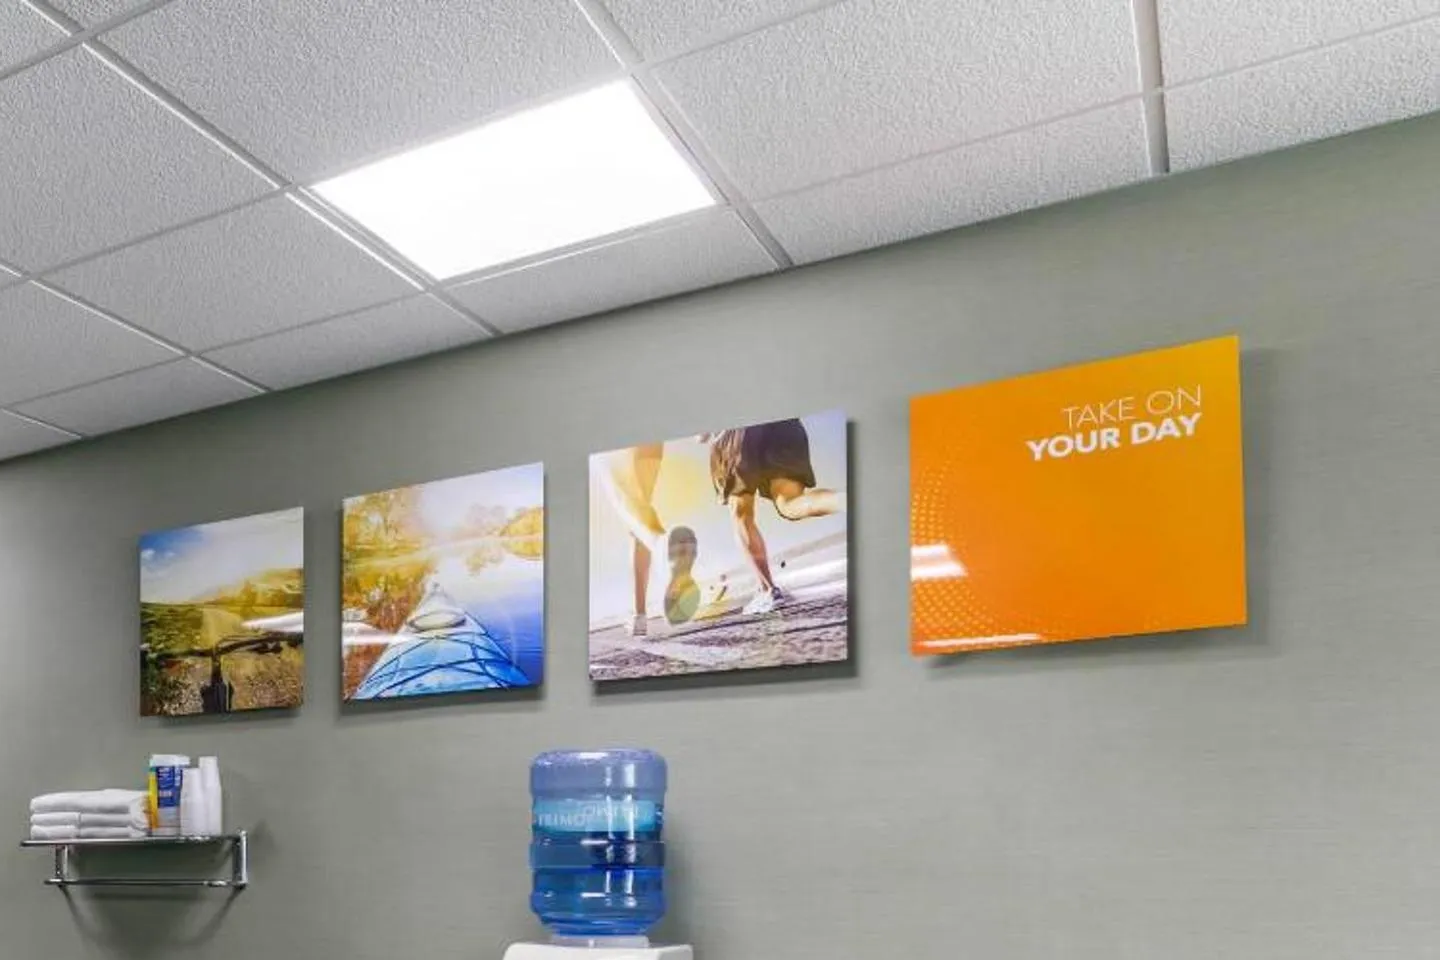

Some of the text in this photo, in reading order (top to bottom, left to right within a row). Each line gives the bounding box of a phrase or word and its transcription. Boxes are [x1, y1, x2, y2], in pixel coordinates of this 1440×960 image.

[1063, 384, 1201, 430] TAKE ON
[1025, 412, 1202, 461] YOUR DAY
